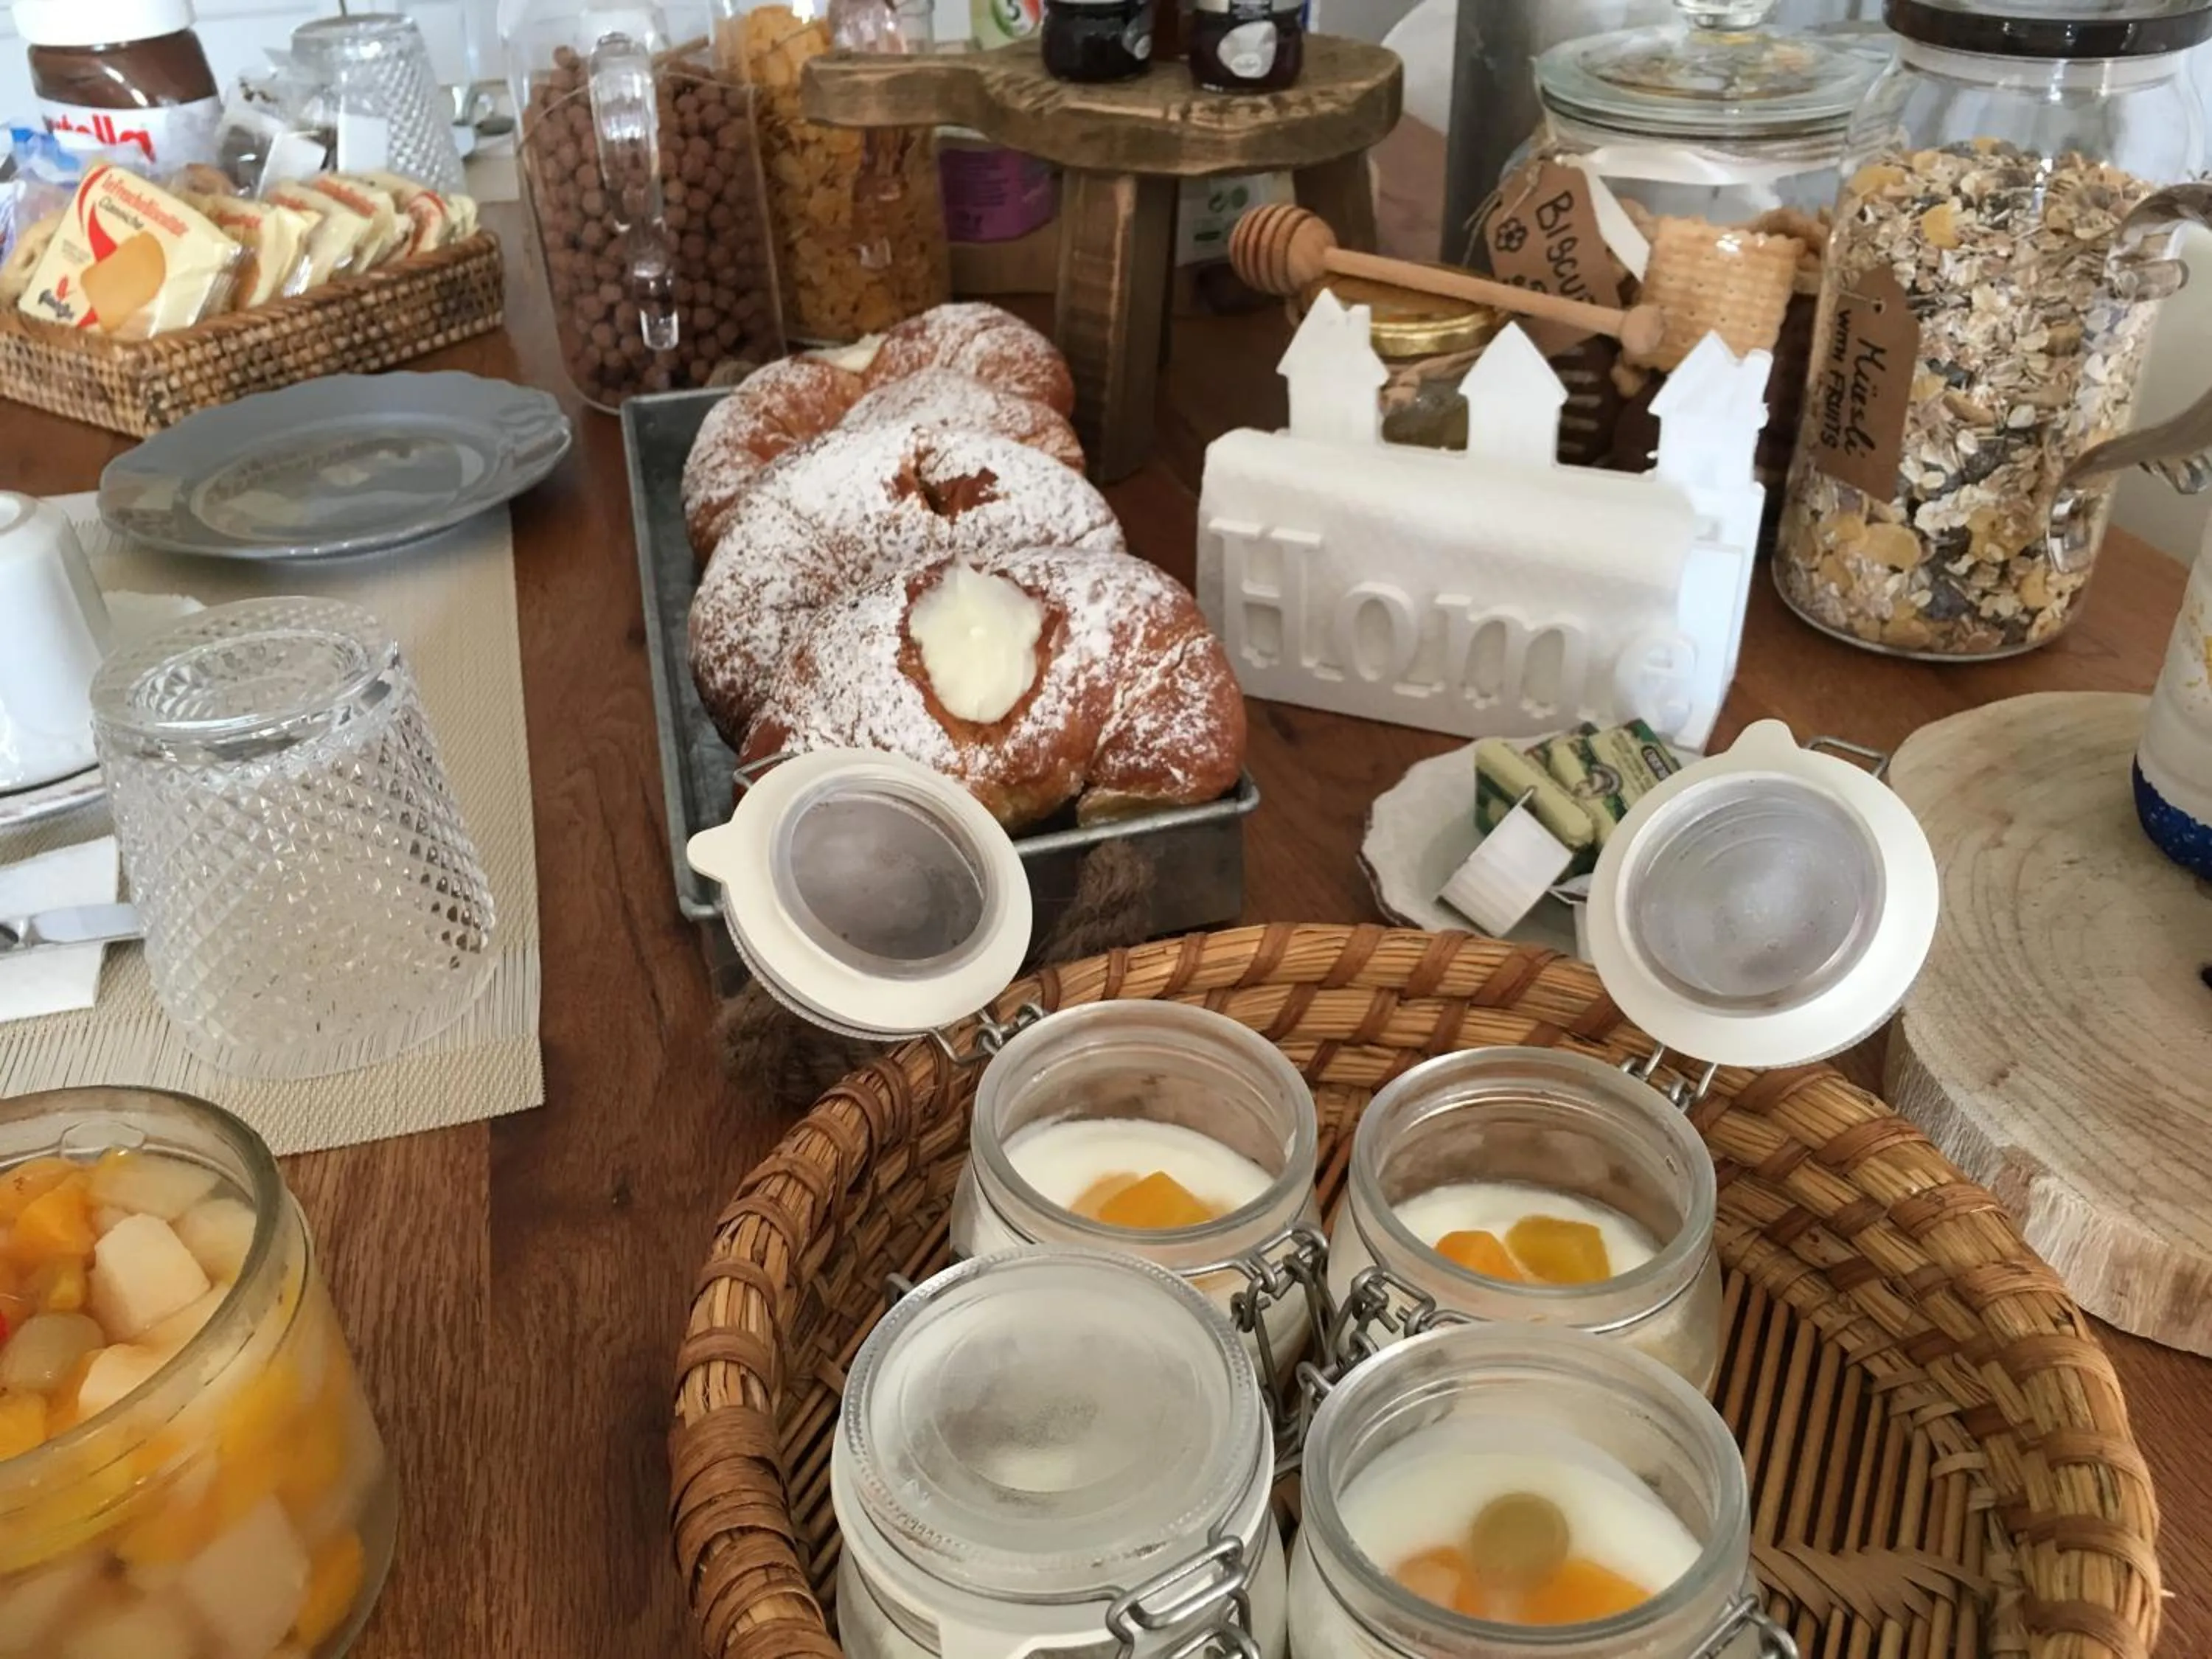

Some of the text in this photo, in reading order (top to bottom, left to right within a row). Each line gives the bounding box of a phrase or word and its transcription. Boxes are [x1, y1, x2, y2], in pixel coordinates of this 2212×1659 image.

[1820, 308, 1852, 449] WITH FRUITS
[1207, 516, 1698, 736] Home
